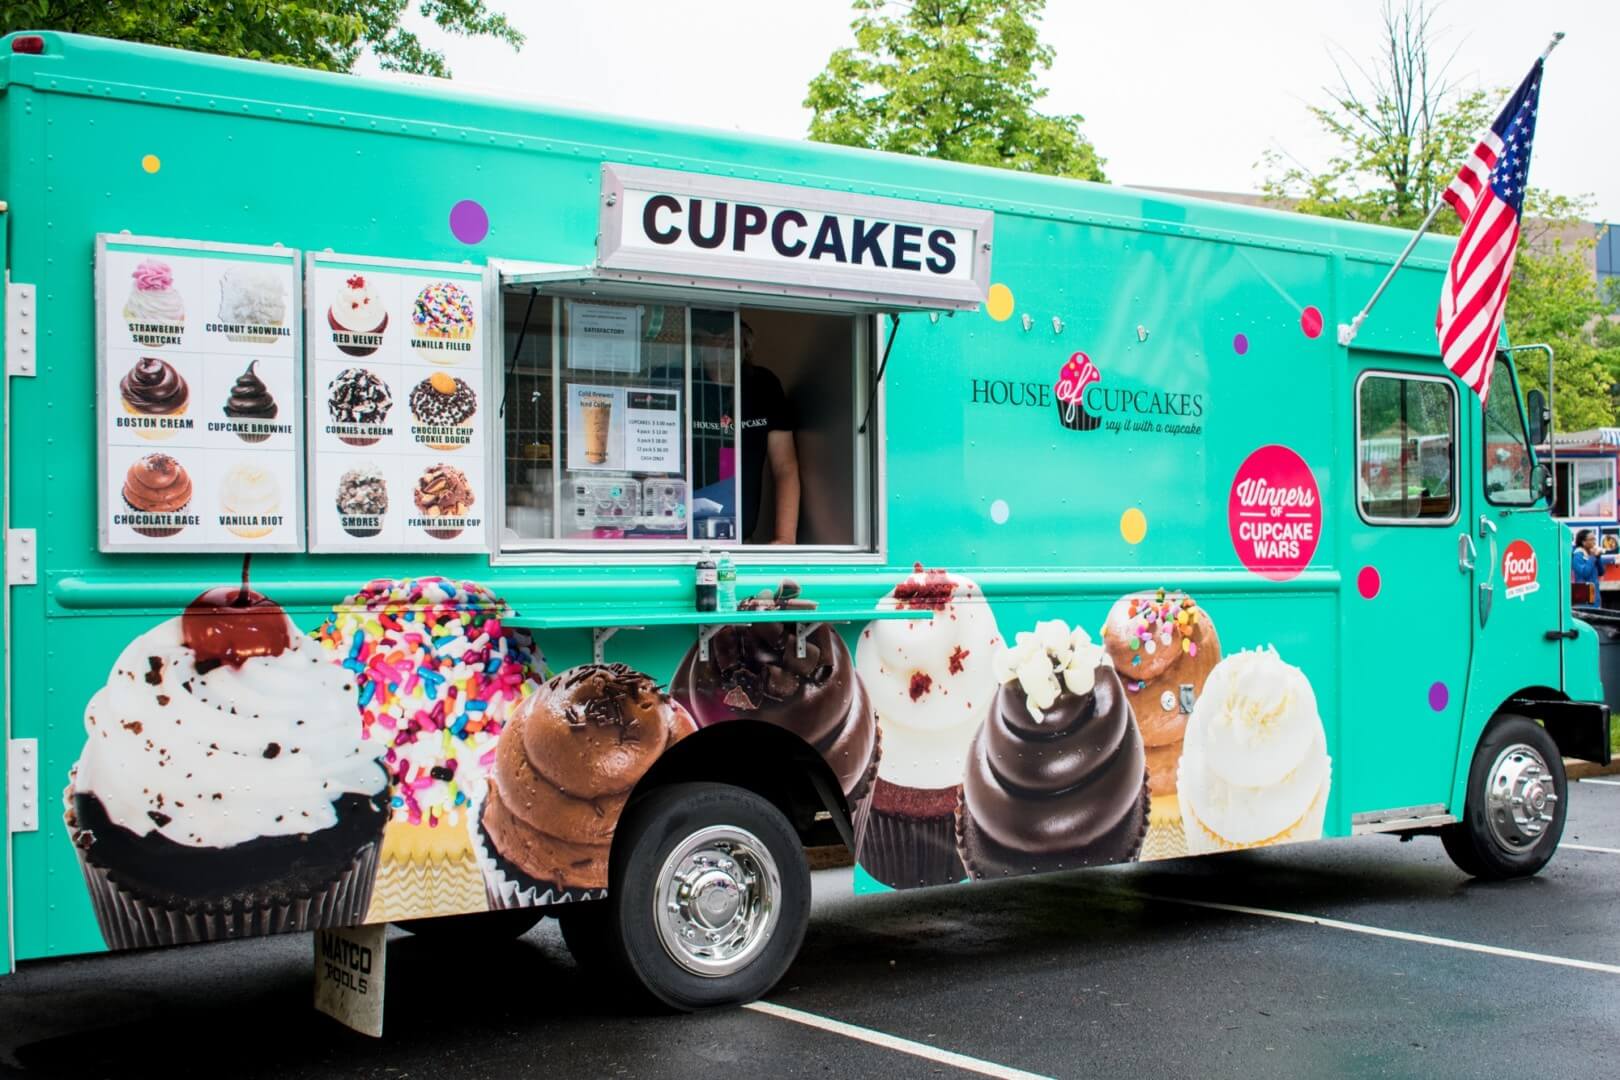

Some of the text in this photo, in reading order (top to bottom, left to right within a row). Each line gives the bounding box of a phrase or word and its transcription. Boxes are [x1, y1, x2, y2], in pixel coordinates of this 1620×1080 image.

[643, 194, 956, 275] CUPCAKES
[128, 323, 185, 334] STRAWBERRY
[206, 323, 291, 336] COCONUT SNOWBALL
[584, 327, 625, 335] SATISFACTORY
[132, 334, 182, 345] SHORTCAKE
[332, 333, 383, 345] RED VELVET
[411, 339, 471, 352] VANILLA FILLED
[971, 362, 1203, 423] HOUSE of CUPCAKES
[116, 417, 194, 429] BOSTON CREAM
[207, 422, 292, 434] CUPCAKE BROWNIE
[694, 420, 720, 431] HOUSE
[1105, 419, 1202, 436] say it with a cupcake
[326, 425, 359, 435] COOKIES
[368, 427, 394, 436] CREAM
[411, 426, 474, 436] CHOCOLATE CHIP
[415, 435, 471, 444] COOKIE DOUGH
[1236, 477, 1315, 507] Winners
[1270, 506, 1283, 517] OF
[114, 514, 200, 526] CHOCOLATE RAGE
[219, 516, 284, 526] VANILLA RIOT
[342, 517, 379, 527] SMORES
[408, 518, 481, 527] PEANUT BUTTER CUP
[1239, 521, 1313, 541] CUPCAKE
[1253, 541, 1300, 559] WARS
[1504, 551, 1536, 583] food
[321, 930, 372, 975] MATCO
